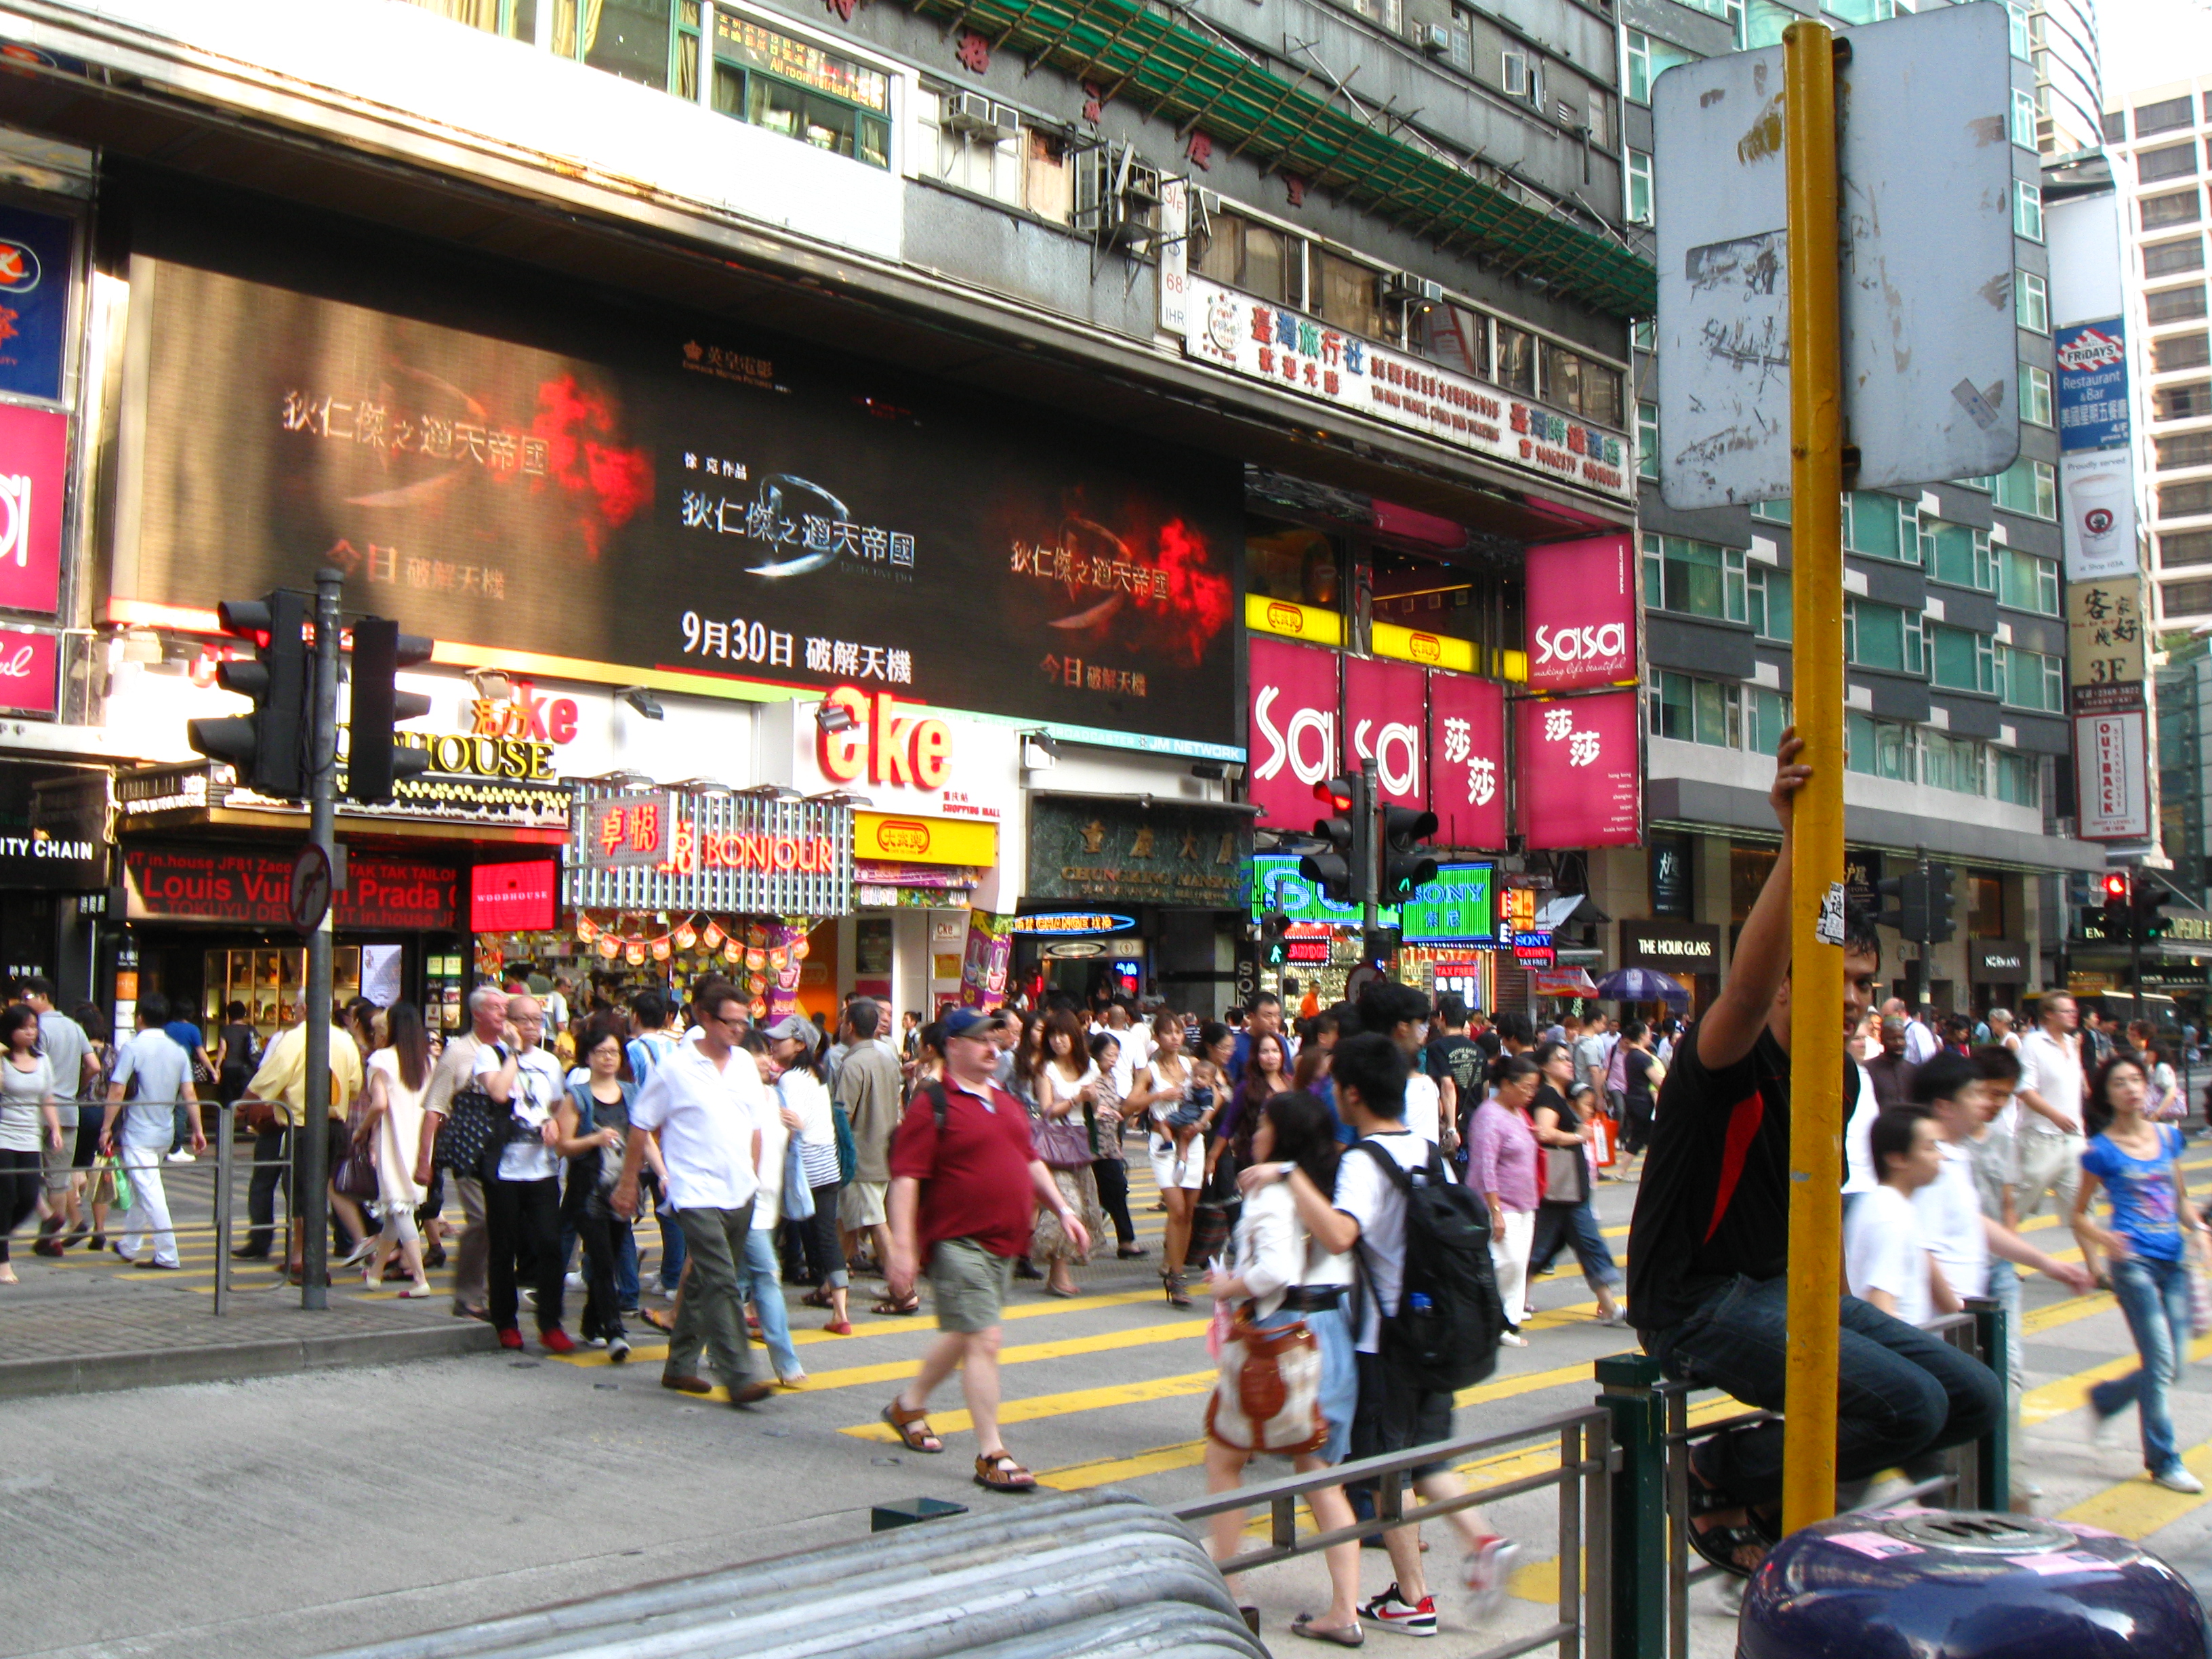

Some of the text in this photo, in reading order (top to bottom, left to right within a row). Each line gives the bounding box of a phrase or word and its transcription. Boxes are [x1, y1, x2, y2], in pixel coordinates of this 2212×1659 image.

[1166, 273, 1183, 294] 68
[2063, 371, 2121, 390] Restaurant
[327, 539, 396, 585] 今日
[805, 637, 912, 684] 破解天機
[1040, 653, 1082, 688] 今日
[2091, 657, 2126, 684] 3F
[1047, 723, 1134, 746] BROADCASTER
[1173, 739, 1239, 760] NETWORK
[1543, 708, 1601, 766] 莎莎
[1443, 716, 1496, 806] 莎莎
[2100, 723, 2113, 814] OUTBACK
[943, 803, 1000, 818] SHOPPING MALL
[34, 840, 93, 861] CHAIN
[705, 833, 833, 874] BONJOUR
[348, 863, 377, 878] TAK
[380, 865, 407, 880] TAK
[1061, 866, 1171, 885] CHUNGKING
[143, 867, 232, 901] Louis
[358, 879, 440, 910] Prada
[476, 891, 548, 902] WOODHOUSE
[1406, 882, 1486, 905] SONY
[1036, 916, 1088, 930] CHANGE
[1515, 935, 1551, 946] SONY
[1638, 939, 1711, 957] THE HOUR GLASS
[1516, 947, 1552, 958] Canon
[1519, 958, 1548, 967] TAX FREE
[1436, 966, 1475, 977] TAX FREE
